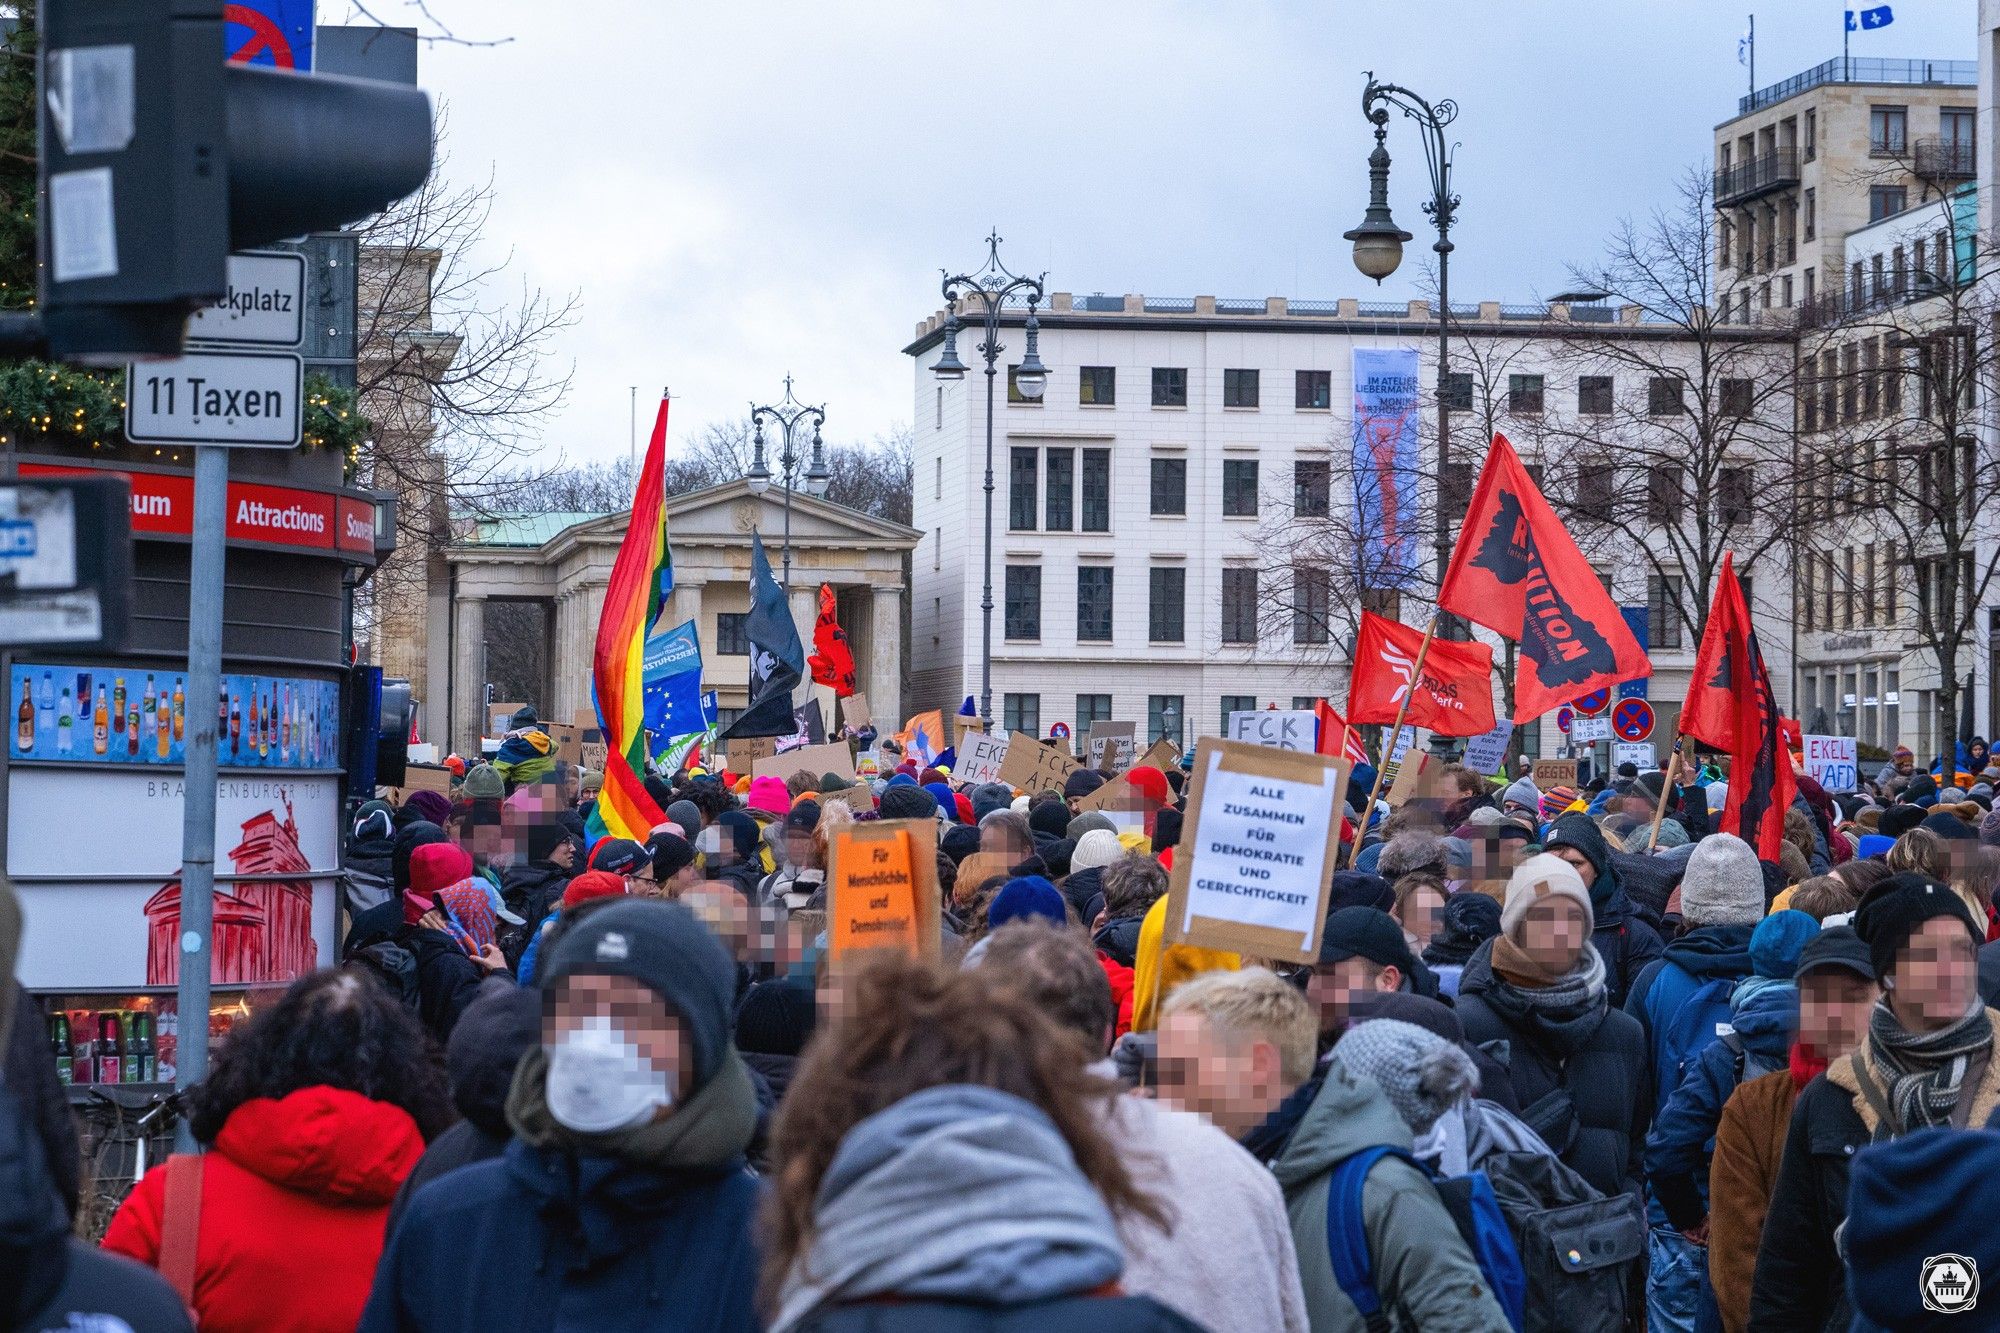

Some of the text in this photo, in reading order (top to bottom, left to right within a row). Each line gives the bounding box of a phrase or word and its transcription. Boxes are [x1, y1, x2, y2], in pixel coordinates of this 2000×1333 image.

[217, 285, 292, 317] ckplatz
[147, 376, 282, 418] 11 Taxen
[236, 500, 324, 533] Attractions
[1238, 717, 1299, 740] FCK
[975, 742, 1008, 764] EKE
[1811, 740, 1855, 760] EKEL-
[1536, 766, 1575, 780] GEGEN
[147, 781, 295, 799] BRAENBURGER
[1249, 785, 1285, 801] ALLE
[1223, 803, 1305, 825] ZUSAMMEN
[1246, 827, 1276, 842] FÜR
[1211, 842, 1304, 866] DEMOKRATIE
[1239, 865, 1271, 880] UND
[1196, 878, 1308, 906] GERECHTIGKEIT
